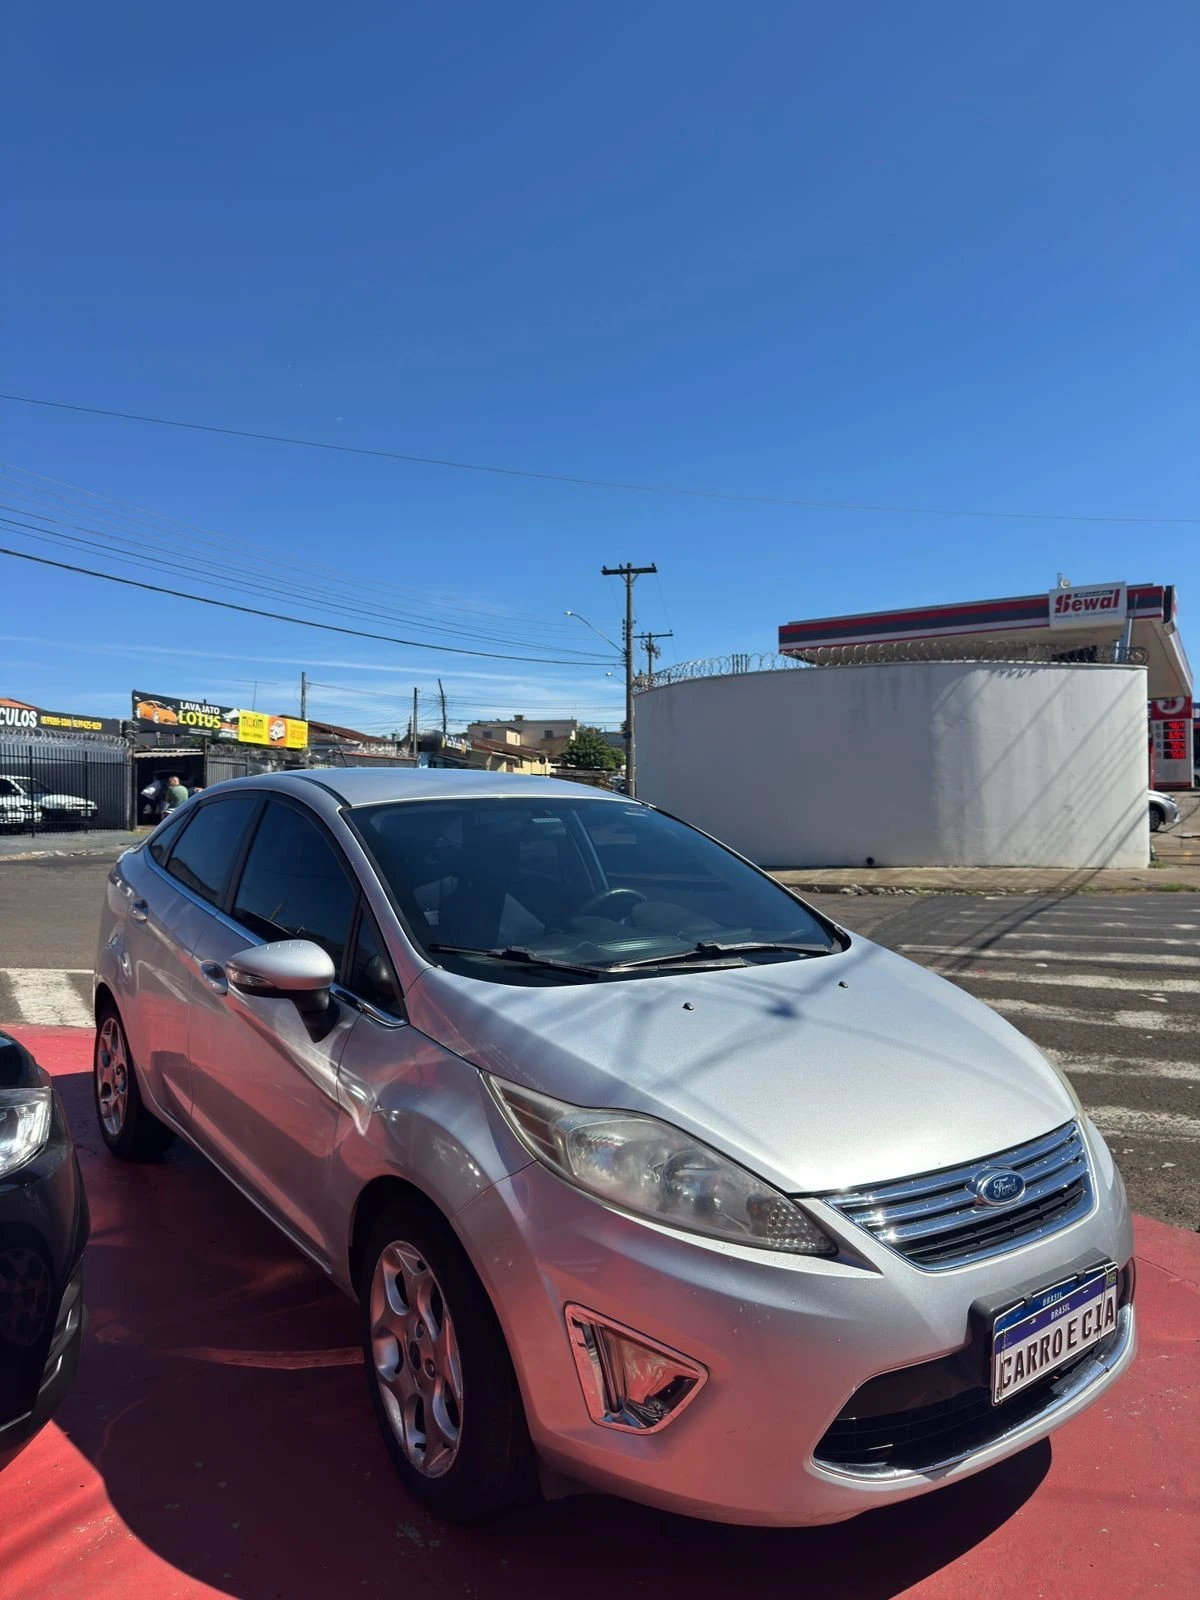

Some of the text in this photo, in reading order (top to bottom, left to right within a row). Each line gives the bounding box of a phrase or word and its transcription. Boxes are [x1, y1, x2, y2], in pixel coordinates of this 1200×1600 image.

[1055, 589, 1121, 613] Sewal
[180, 701, 220, 715] LAVA JATO
[178, 710, 221, 729] LOTUS
[993, 1177, 1017, 1198] Ford
[1042, 1291, 1063, 1307] BRASIL
[1050, 1303, 1071, 1320] BRASIL
